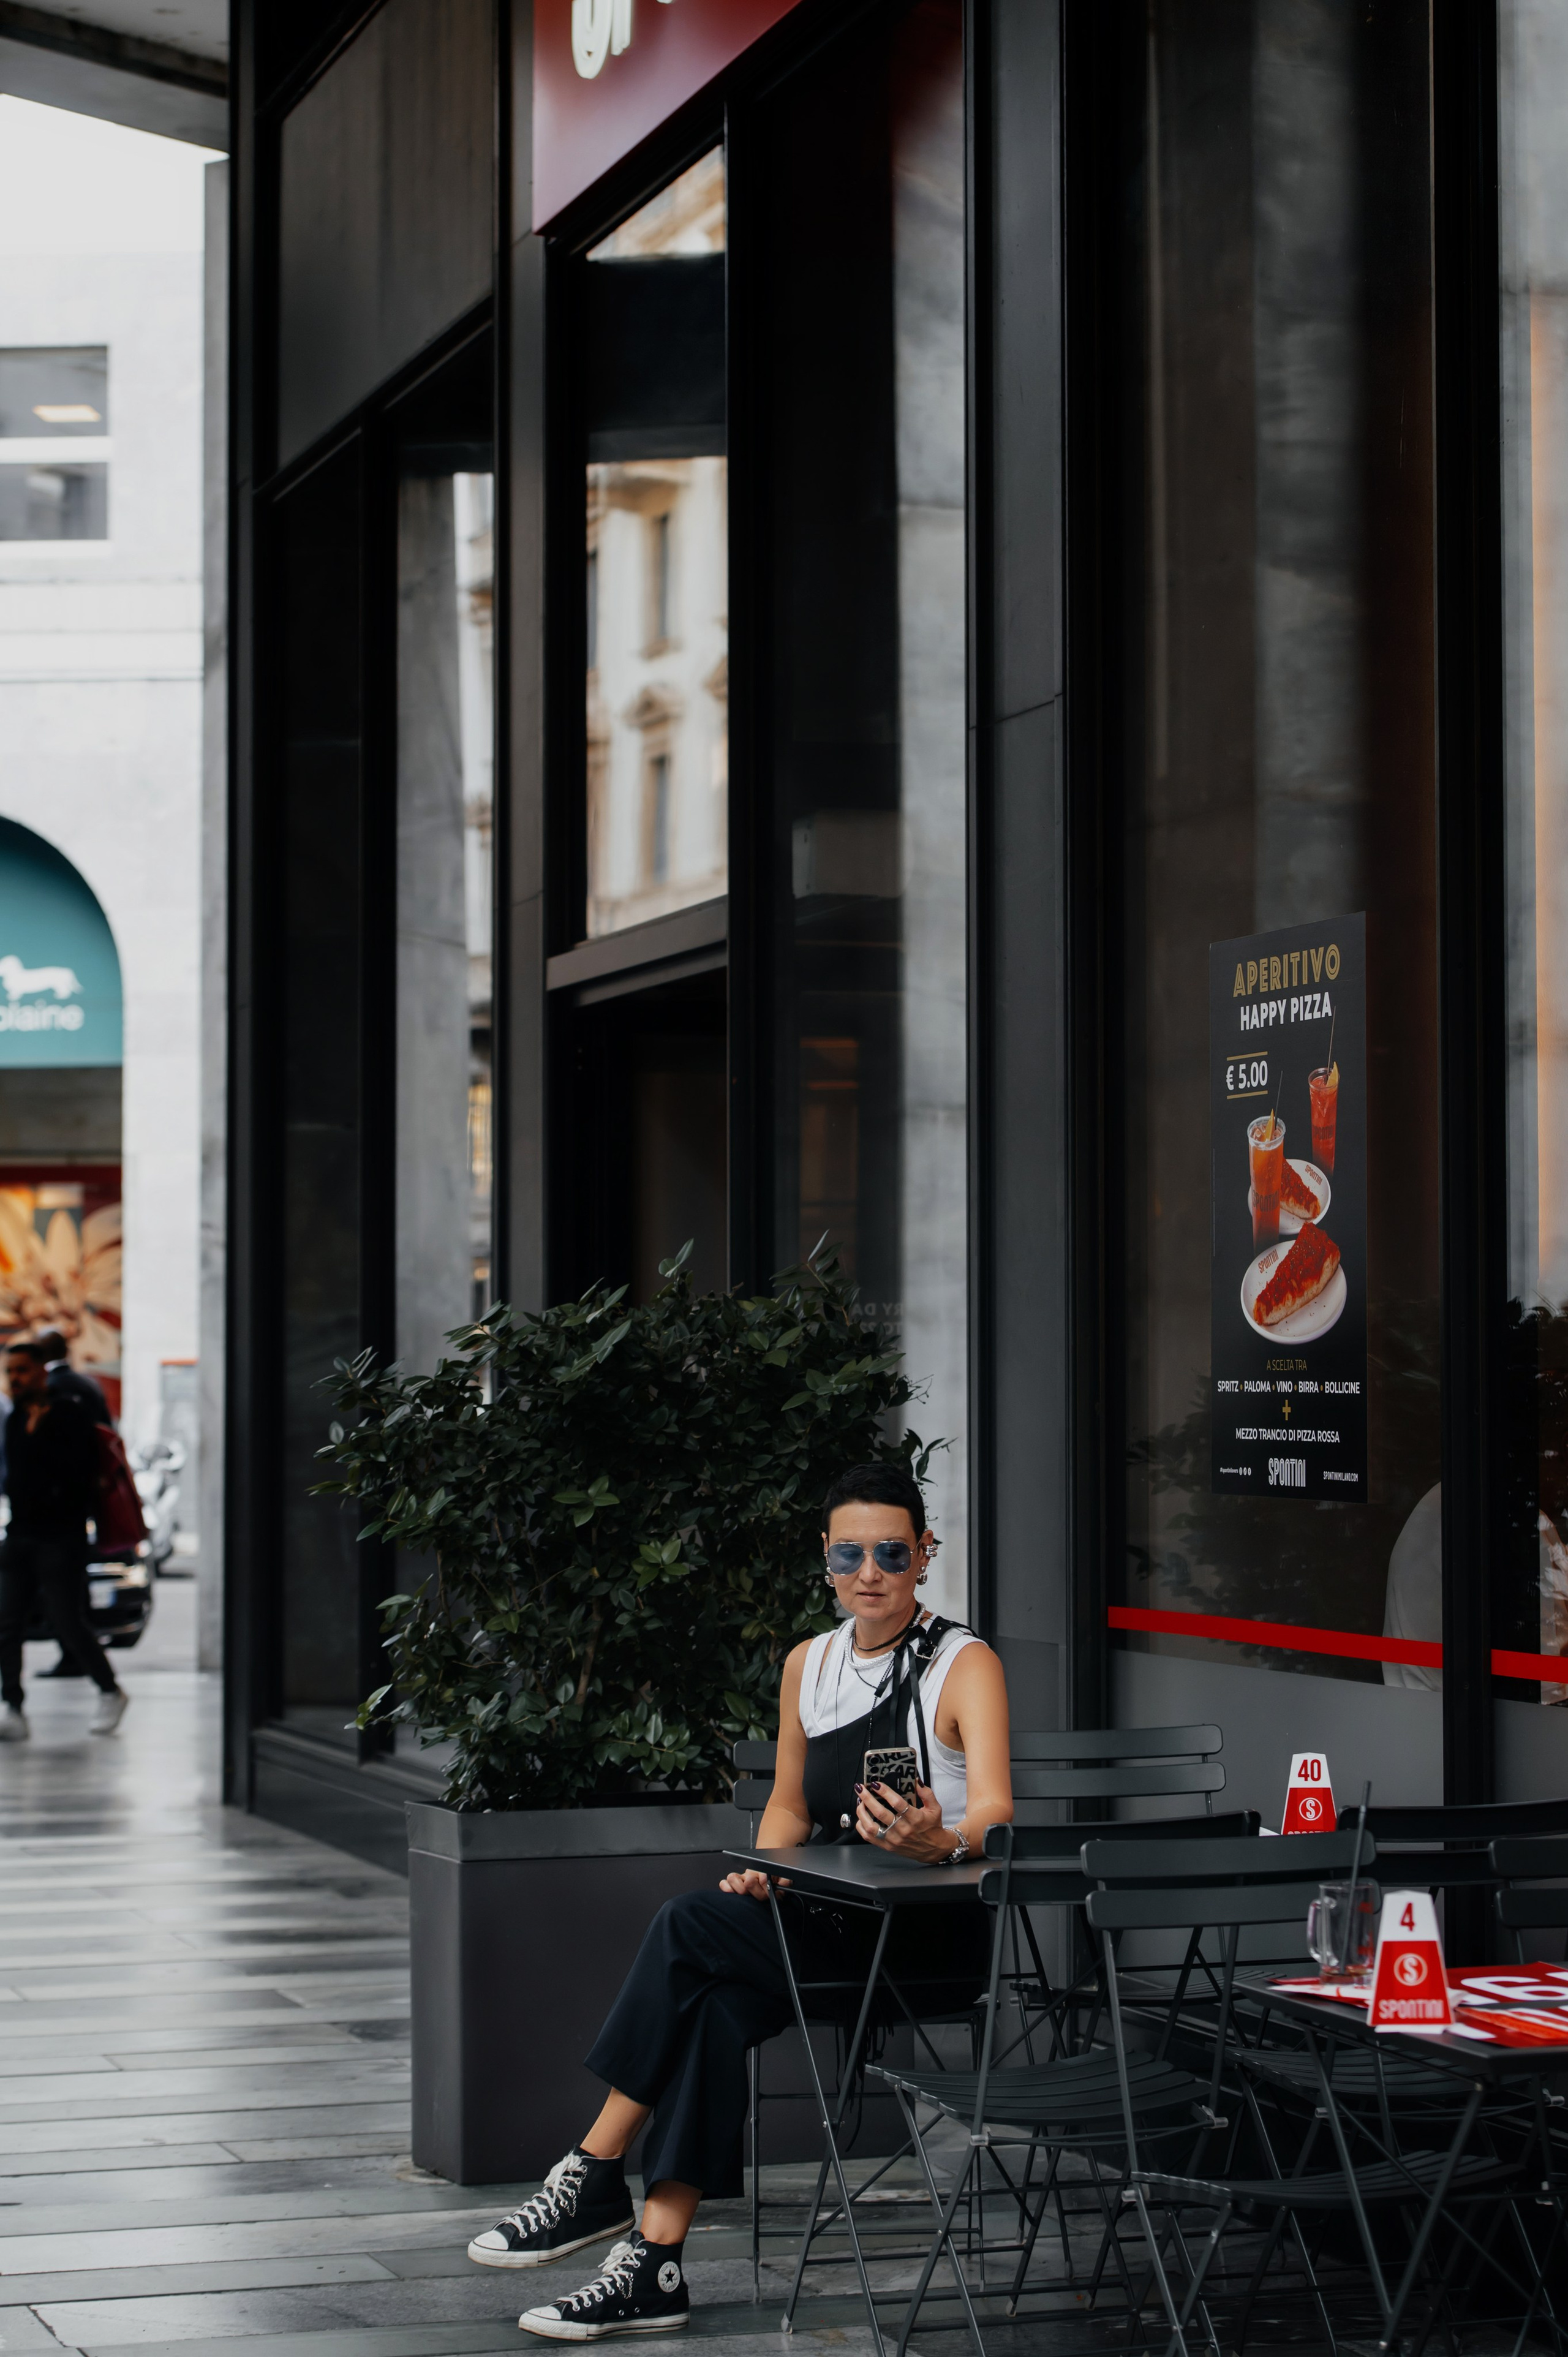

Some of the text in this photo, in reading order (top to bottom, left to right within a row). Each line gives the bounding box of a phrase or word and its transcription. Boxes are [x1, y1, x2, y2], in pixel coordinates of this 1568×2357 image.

[1233, 944, 1341, 997] APERITIVO
[1240, 992, 1332, 1031] HAPPY PIZZA
[1305, 1164, 1323, 1186] SPONTINI
[1258, 1249, 1279, 1274] SPONTINI
[1267, 1360, 1307, 1371] A SCELTA TRA
[1218, 1381, 1360, 1393] SPRITZ PALOMA VINO BIRRA BOLLICINE
[1236, 1428, 1340, 1442] MEZZO TRANCIO DI PIZZA ROSSA
[1268, 1457, 1306, 1487] SPONTINI
[1298, 1759, 1322, 1782] 40
[1400, 1903, 1415, 1932] 4
[1379, 2000, 1444, 2019] SPONTINI
